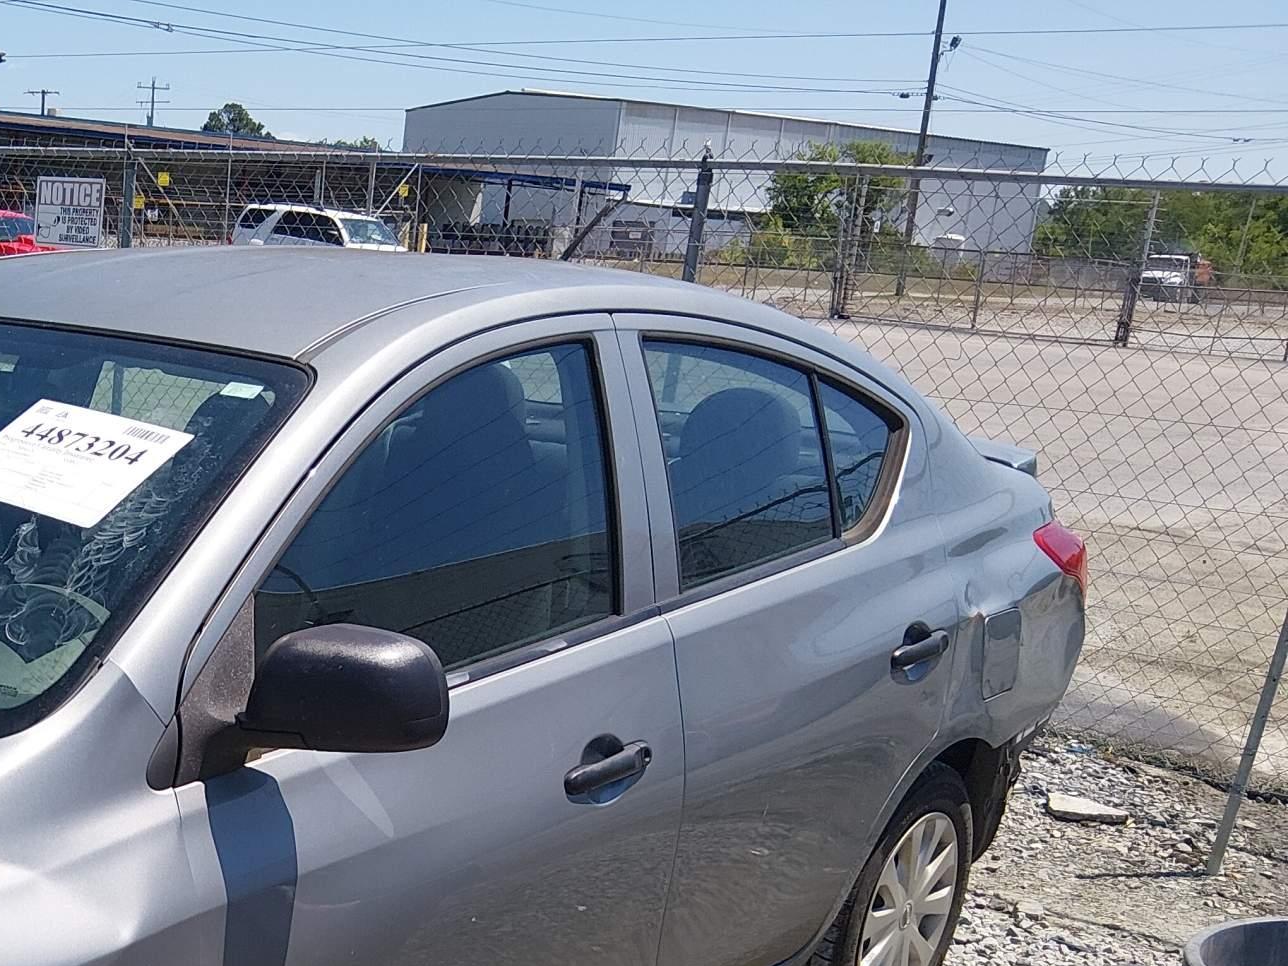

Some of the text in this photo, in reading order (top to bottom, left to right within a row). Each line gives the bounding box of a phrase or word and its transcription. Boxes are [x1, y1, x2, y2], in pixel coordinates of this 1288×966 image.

[40, 181, 101, 207] NOTICE
[60, 206, 99, 217] THIS PROPERTY
[61, 216, 98, 226] IS PROTECTED
[66, 225, 90, 235] BY VIDEO
[58, 234, 96, 244] SURVEILLANCE
[21, 422, 148, 466] 44873204
